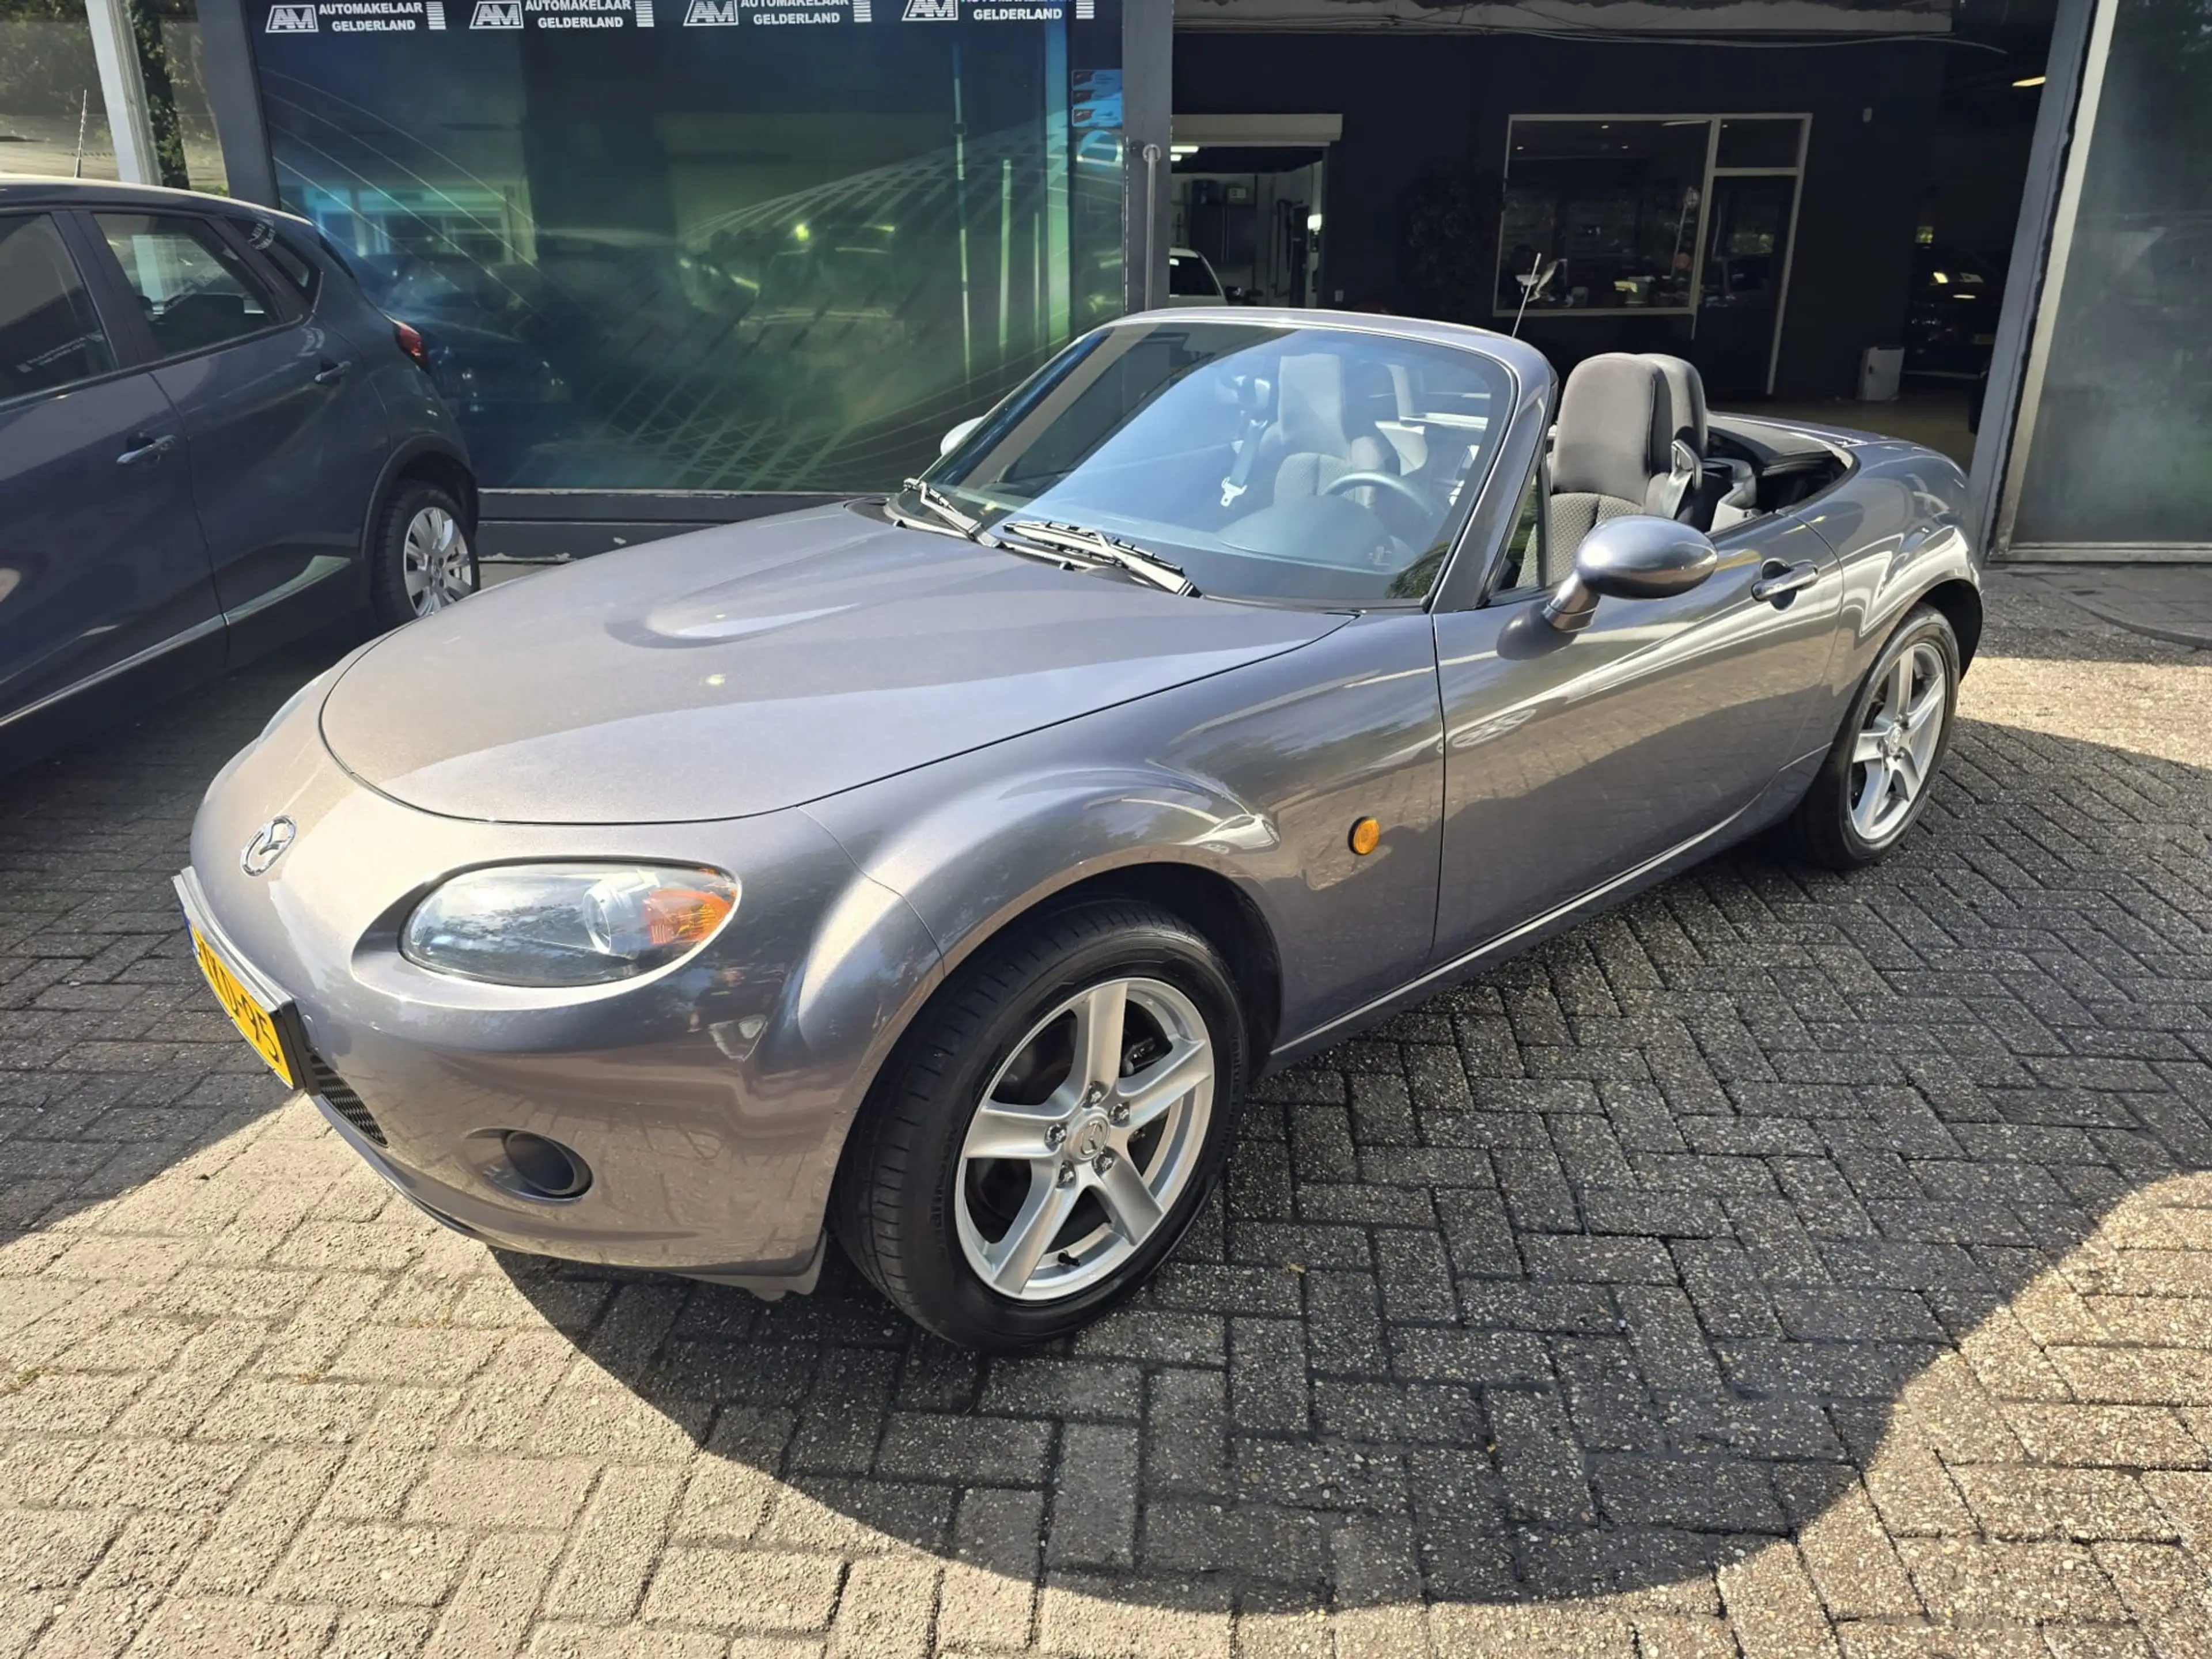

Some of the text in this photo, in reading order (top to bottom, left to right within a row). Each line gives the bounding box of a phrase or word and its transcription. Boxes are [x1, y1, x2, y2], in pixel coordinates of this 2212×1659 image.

[319, 2, 423, 15] AUTOMAKELAAR
[525, 0, 632, 11] AUTOMAKELAAR
[271, 8, 314, 29] AM
[475, 4, 520, 25] AM
[753, 12, 840, 25] GELDERLAND
[973, 8, 1063, 21] GELDERLAND
[331, 20, 416, 32] GELDERLAND
[537, 16, 623, 29] GELDERLAND
